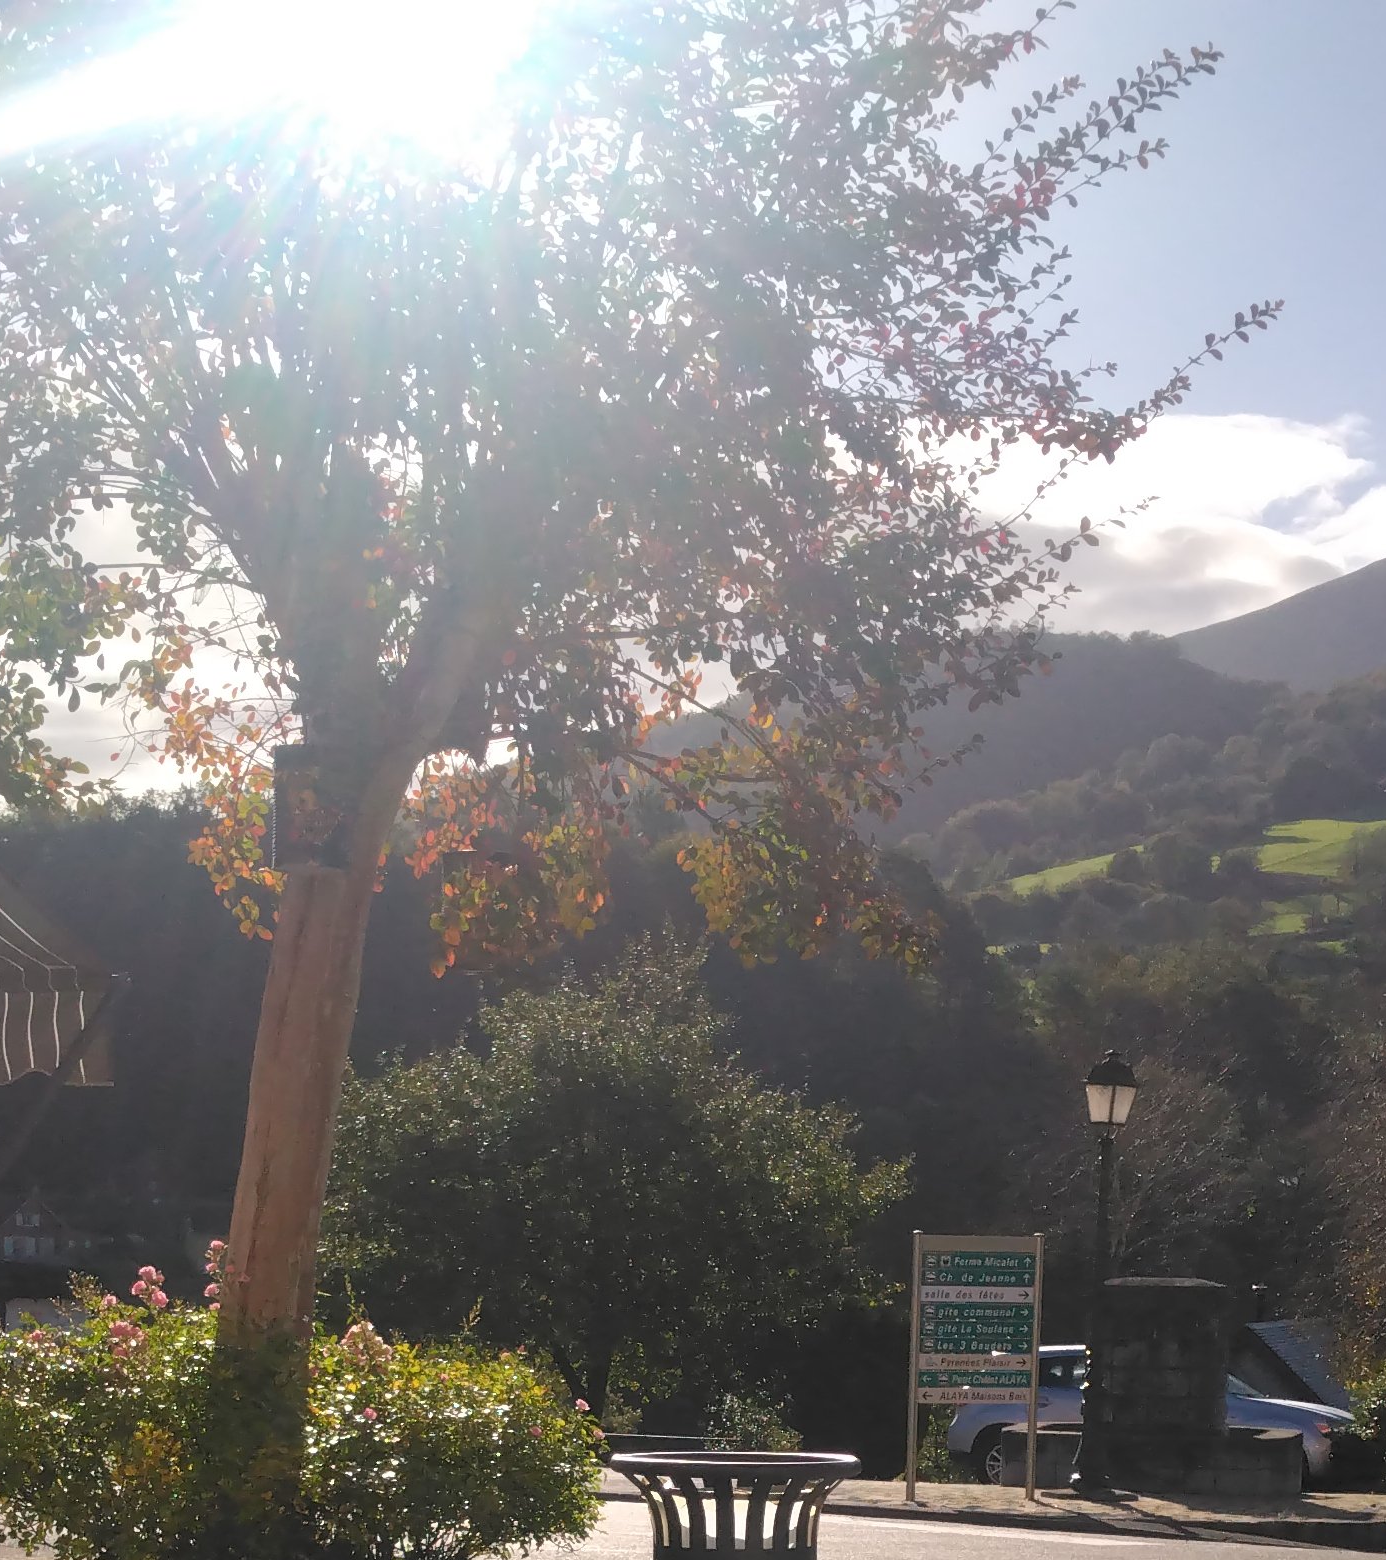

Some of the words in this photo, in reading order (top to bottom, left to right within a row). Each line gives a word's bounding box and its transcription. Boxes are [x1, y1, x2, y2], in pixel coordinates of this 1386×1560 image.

[961, 1272, 974, 1282] de
[978, 1273, 1016, 1283] Jeanne
[924, 1289, 950, 1299] salle
[955, 1290, 973, 1299] des
[979, 1290, 1005, 1300] fêtes
[963, 1308, 1015, 1317] communal
[937, 1340, 954, 1350] Les
[959, 1340, 967, 1350] 3
[983, 1357, 1011, 1367] Plaisir
[999, 1375, 1027, 1385] ALAYA
[939, 1392, 969, 1401] ALAYA
[971, 1392, 1006, 1401] Maisons
